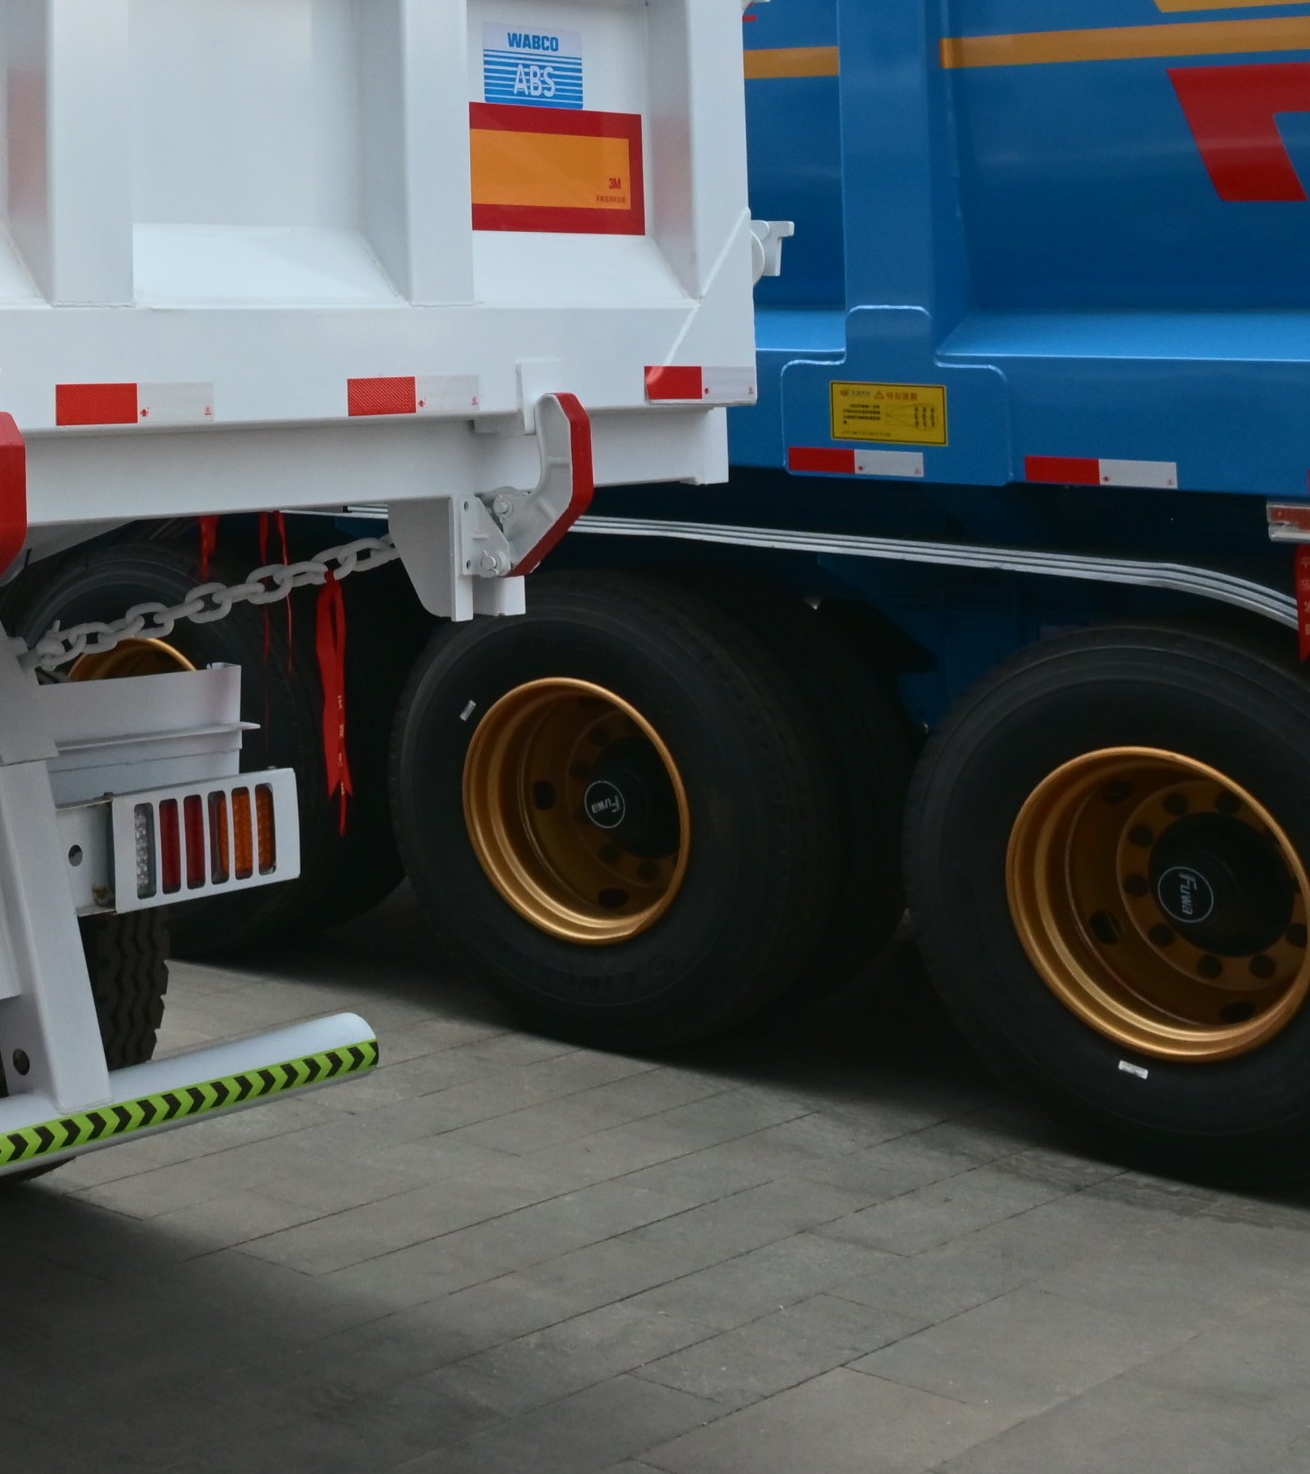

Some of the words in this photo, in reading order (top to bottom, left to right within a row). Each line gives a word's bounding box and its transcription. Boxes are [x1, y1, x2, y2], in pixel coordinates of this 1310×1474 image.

[507, 32, 559, 52] WABCO
[513, 64, 556, 97] ABS
[608, 177, 622, 190] 3M
[591, 794, 620, 814] Fuwa
[1178, 871, 1198, 915] Fuwa
